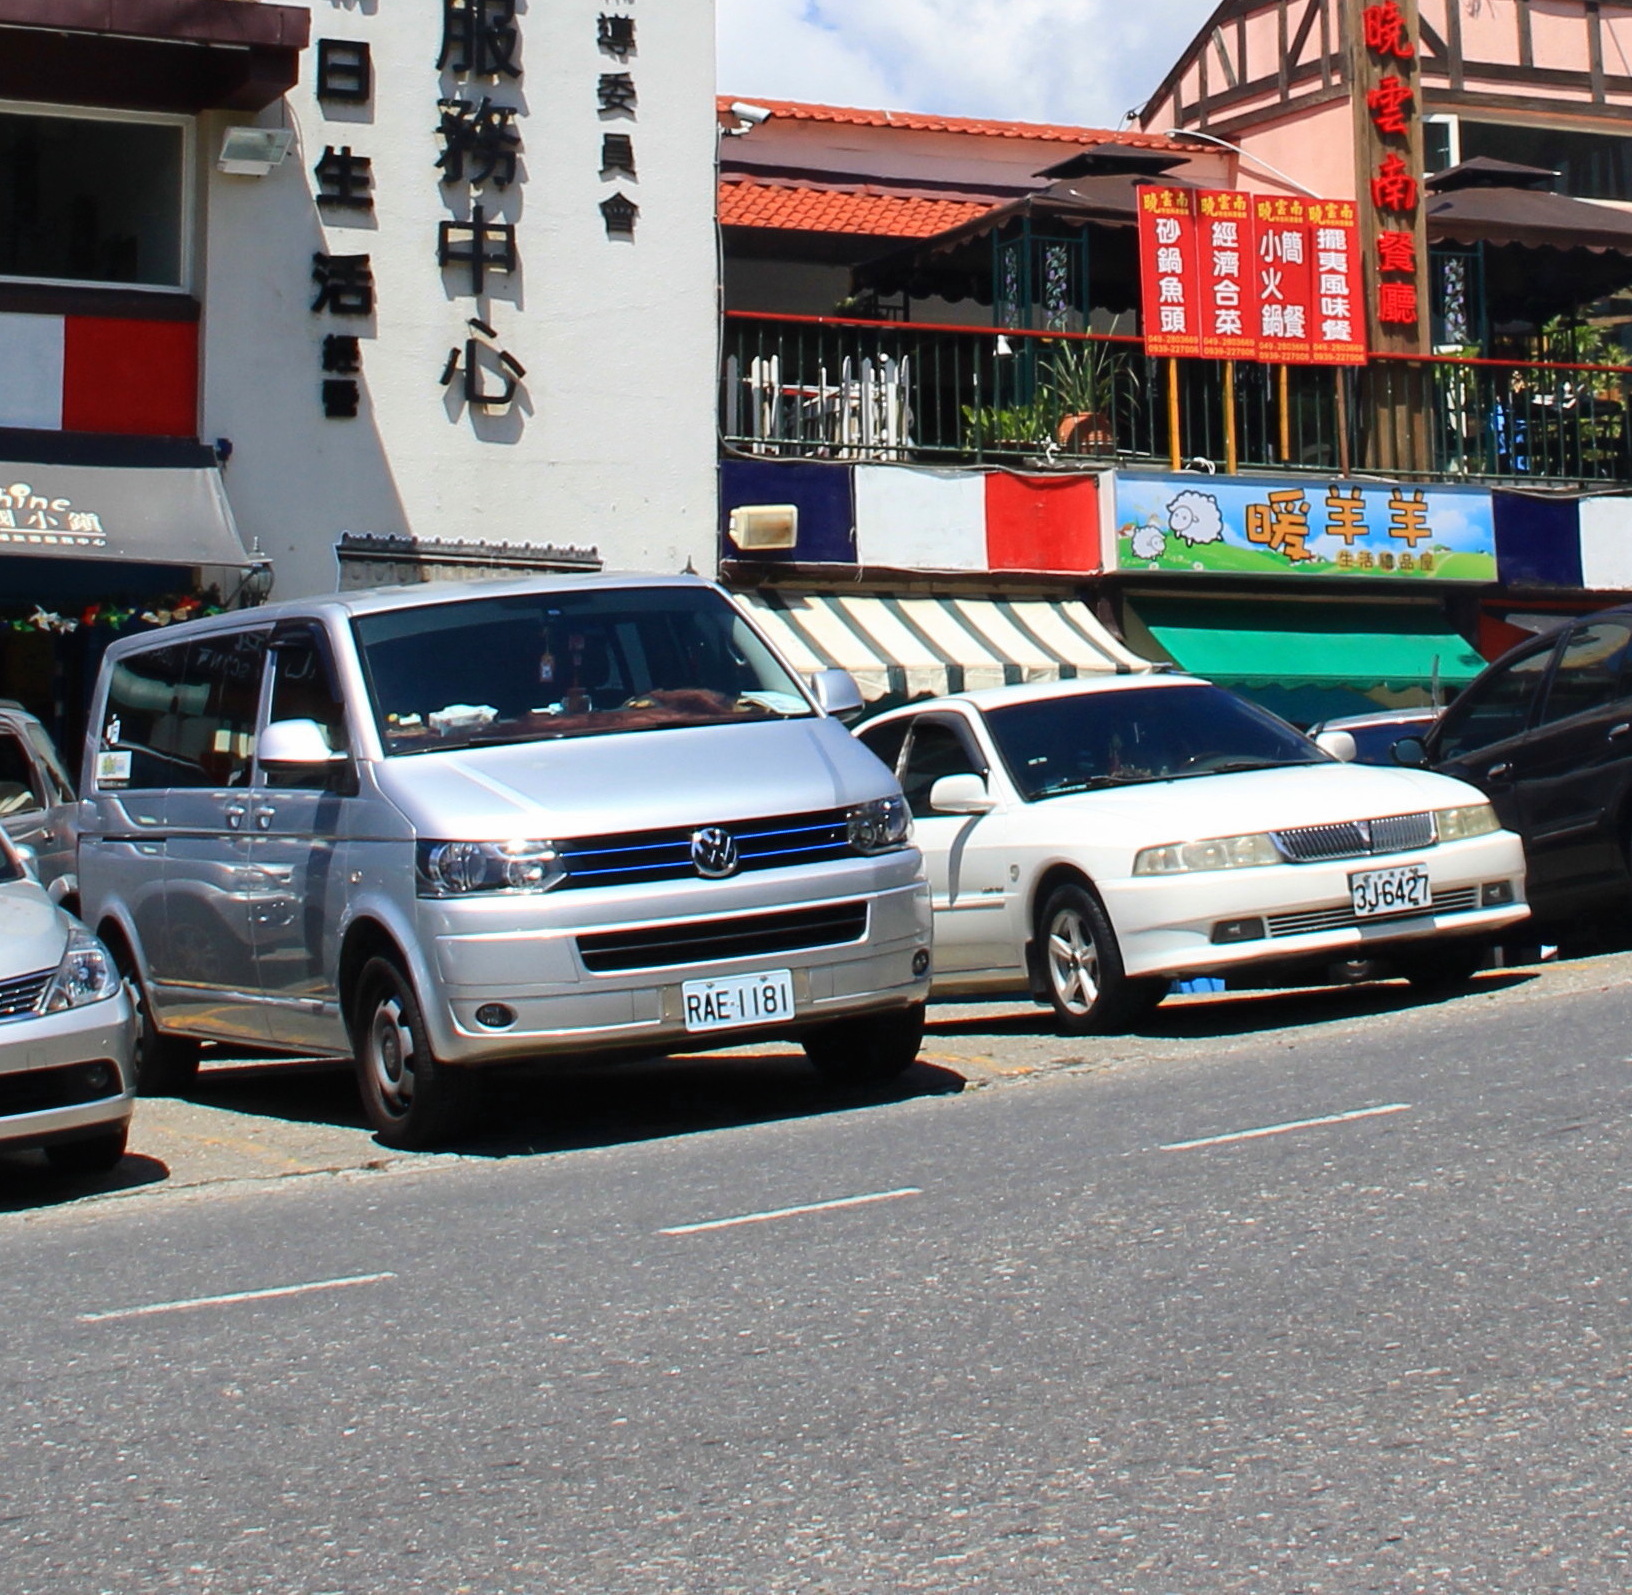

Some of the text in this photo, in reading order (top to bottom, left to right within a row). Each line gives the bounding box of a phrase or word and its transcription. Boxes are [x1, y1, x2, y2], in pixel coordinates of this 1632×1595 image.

[1156, 218, 1187, 334] 砂鍋魚頭
[1211, 221, 1243, 336] 經濟合菜
[1260, 229, 1284, 338] 小火鍋
[1281, 230, 1306, 339] 簡餐
[1317, 228, 1352, 341] 擺夷風味餐
[1246, 484, 1433, 562] 暖羊羊
[1354, 874, 1429, 910] 3J-6427
[687, 982, 788, 1024] RAE-1181
